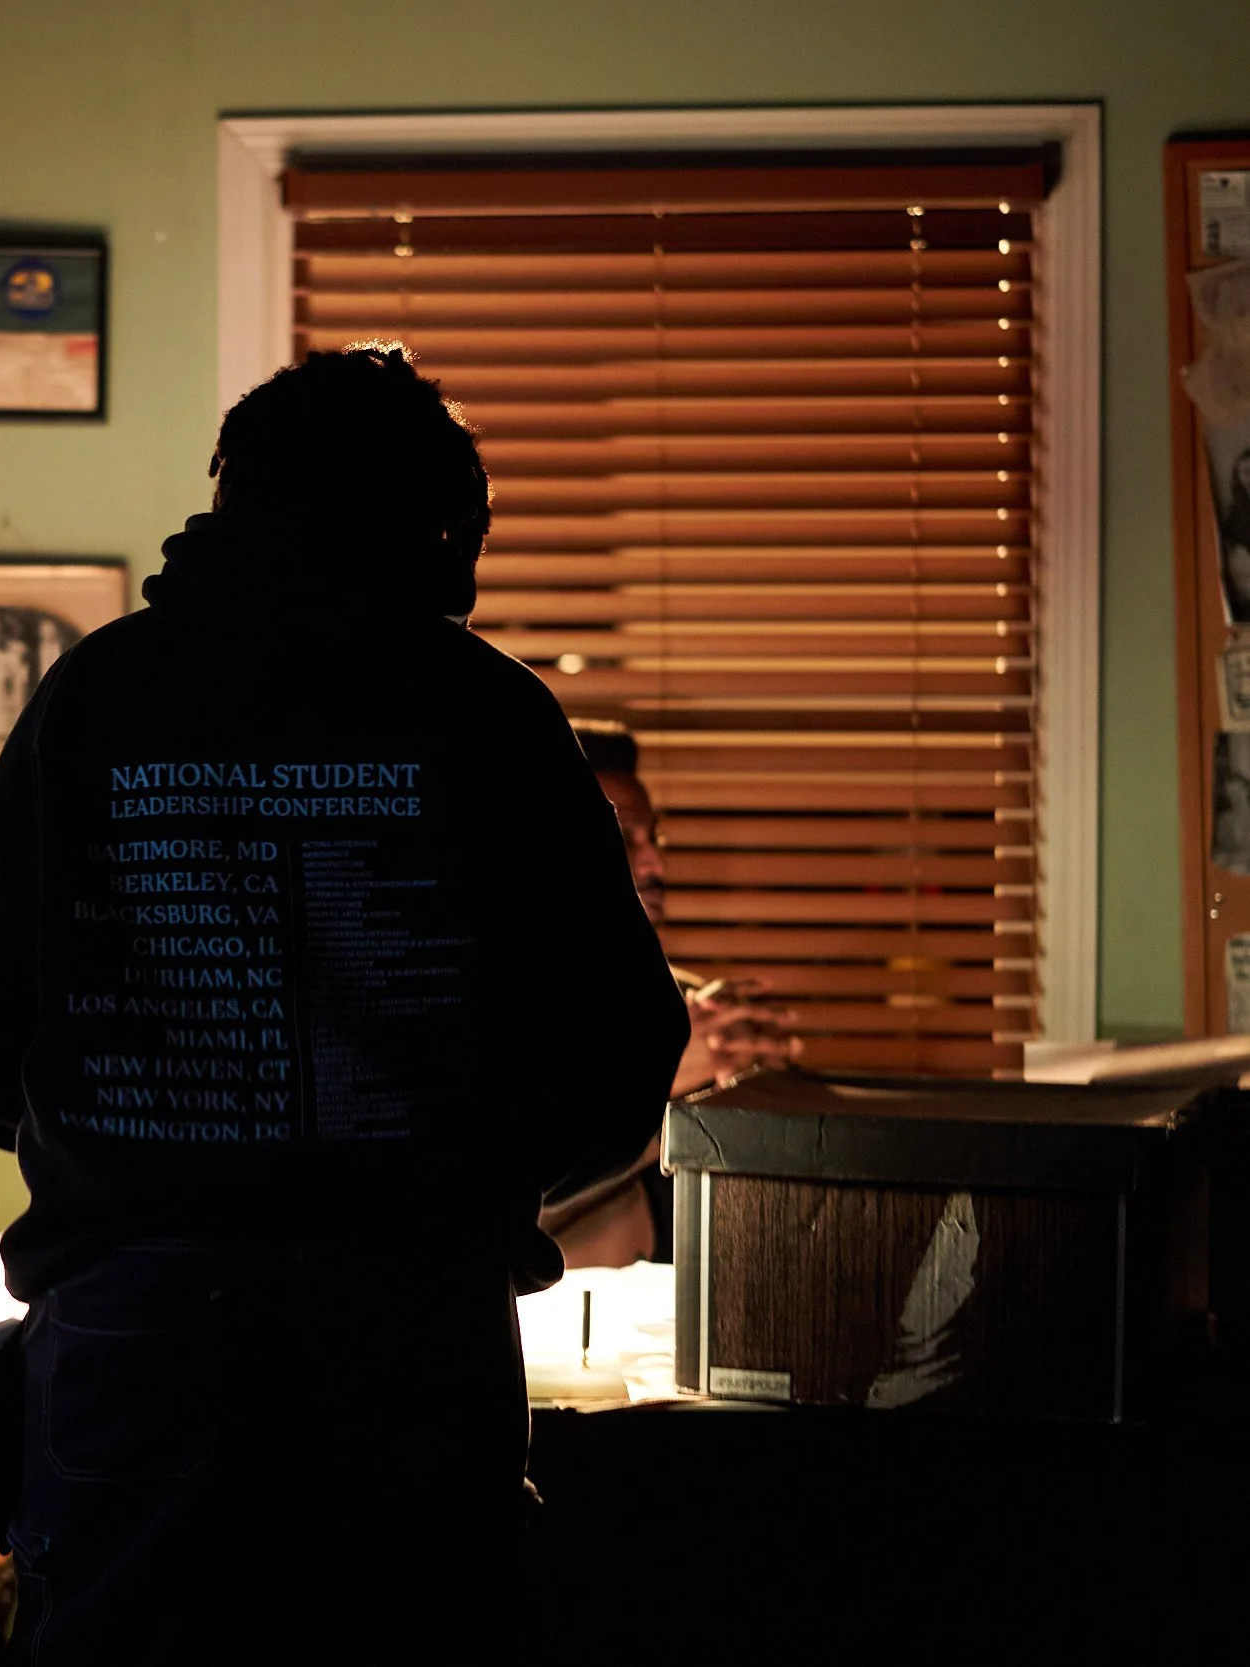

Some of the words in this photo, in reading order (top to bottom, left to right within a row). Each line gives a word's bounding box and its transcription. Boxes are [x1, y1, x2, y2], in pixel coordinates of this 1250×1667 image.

[111, 762, 266, 792] NATIONAL
[270, 763, 421, 790] STUDENT
[110, 795, 254, 820] LEADERSHIP
[259, 796, 421, 818] CONFERENCE
[88, 839, 230, 864] BALTIMORE,
[237, 840, 278, 861] MD
[110, 872, 238, 895] BERKELEY,
[244, 874, 280, 894] CA
[73, 901, 239, 927] BLACKSBURG,
[245, 905, 280, 924] VA
[133, 936, 251, 959] CHICAGO,
[258, 936, 283, 956] IL
[124, 966, 242, 991] DURHAM,
[246, 967, 282, 987] NC
[67, 991, 116, 1015] LOS
[124, 995, 248, 1023] ANGELES,
[251, 996, 284, 1020] CA
[166, 1028, 254, 1053] MIAMI,
[259, 1028, 288, 1052] FL
[82, 1053, 146, 1078] NEW
[154, 1056, 251, 1083] HAVEN,
[257, 1058, 292, 1082] CT
[97, 1084, 158, 1109] NEW
[166, 1089, 247, 1116] YORK,
[254, 1090, 291, 1115] NY
[58, 1107, 247, 1143] WASHINGTON,
[255, 1121, 290, 1143] DC
